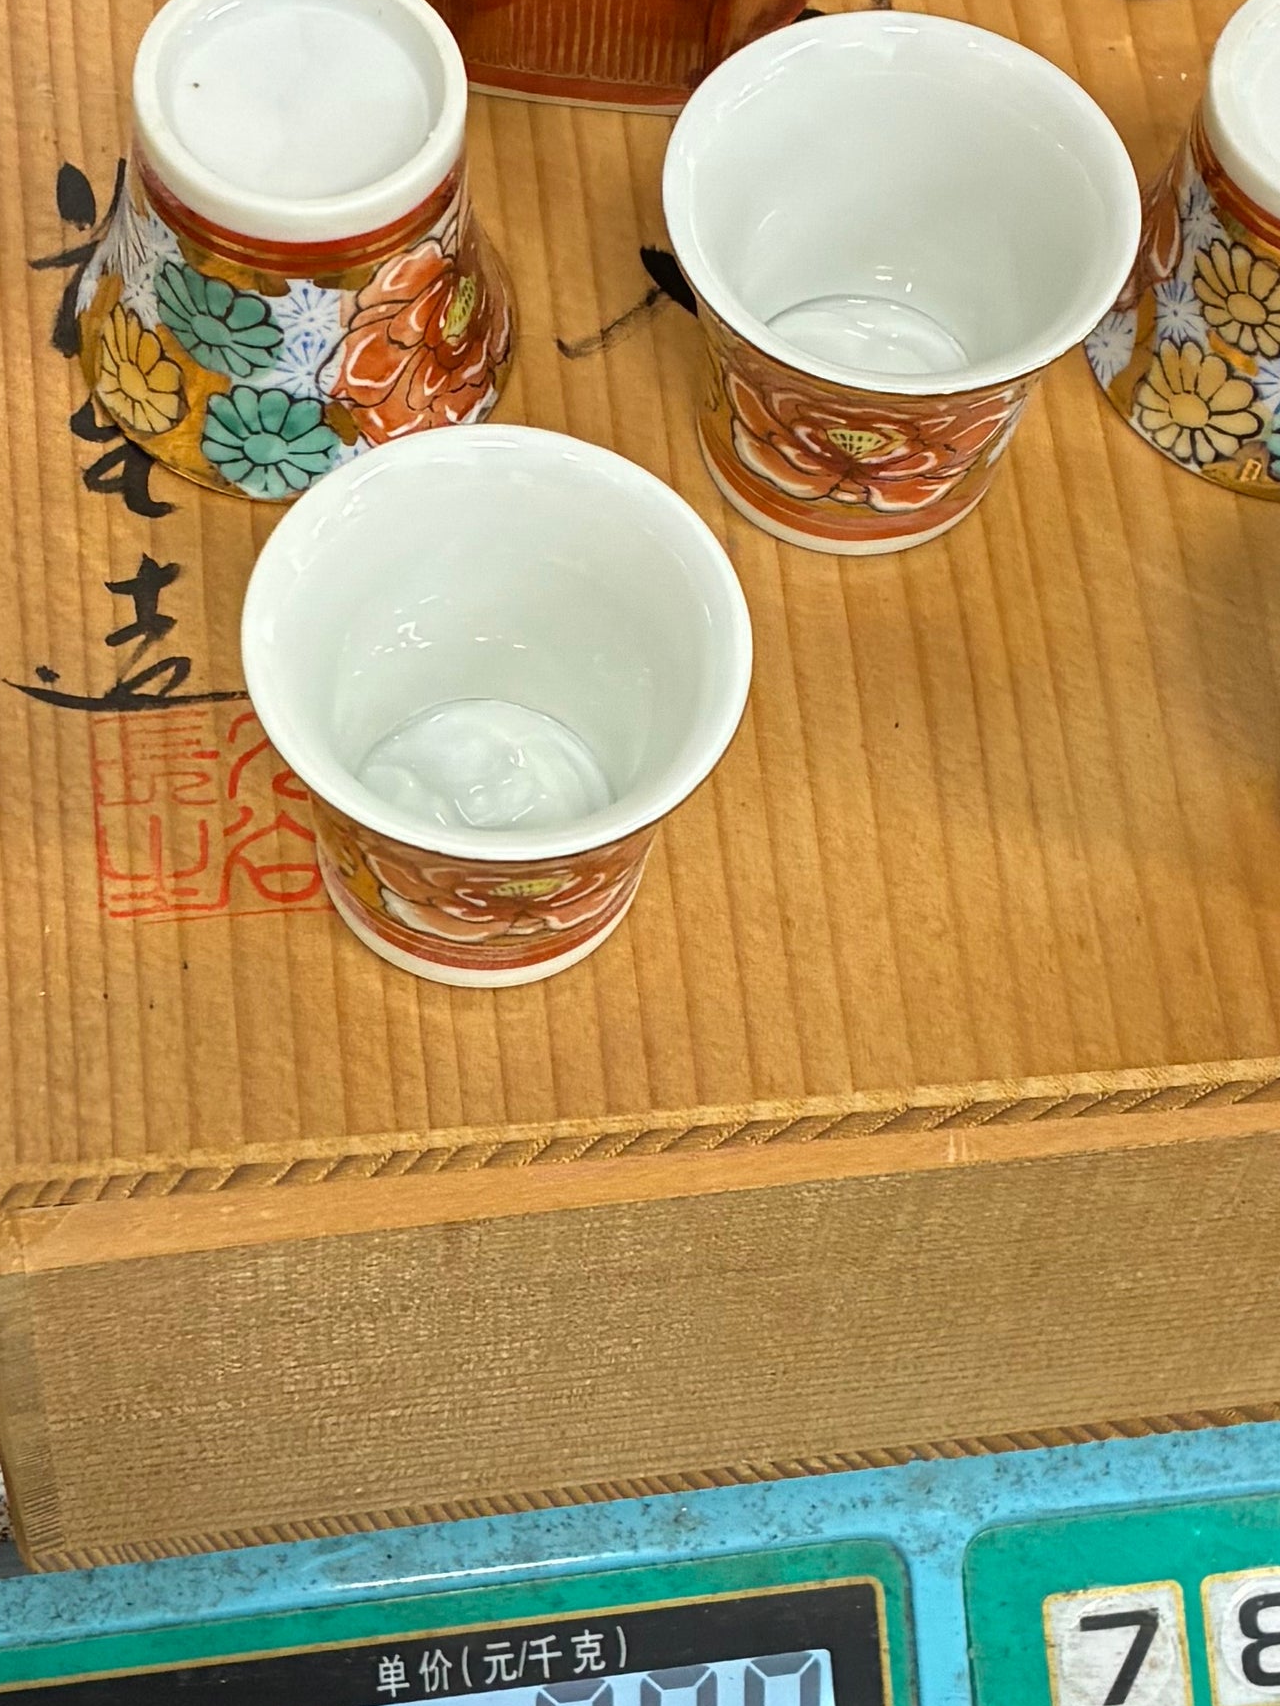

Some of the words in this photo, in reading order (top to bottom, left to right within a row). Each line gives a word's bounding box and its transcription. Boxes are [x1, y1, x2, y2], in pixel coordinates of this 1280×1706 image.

[376, 1625, 629, 1697] 单价(元/千克)
[1080, 1607, 1160, 1706] 7
